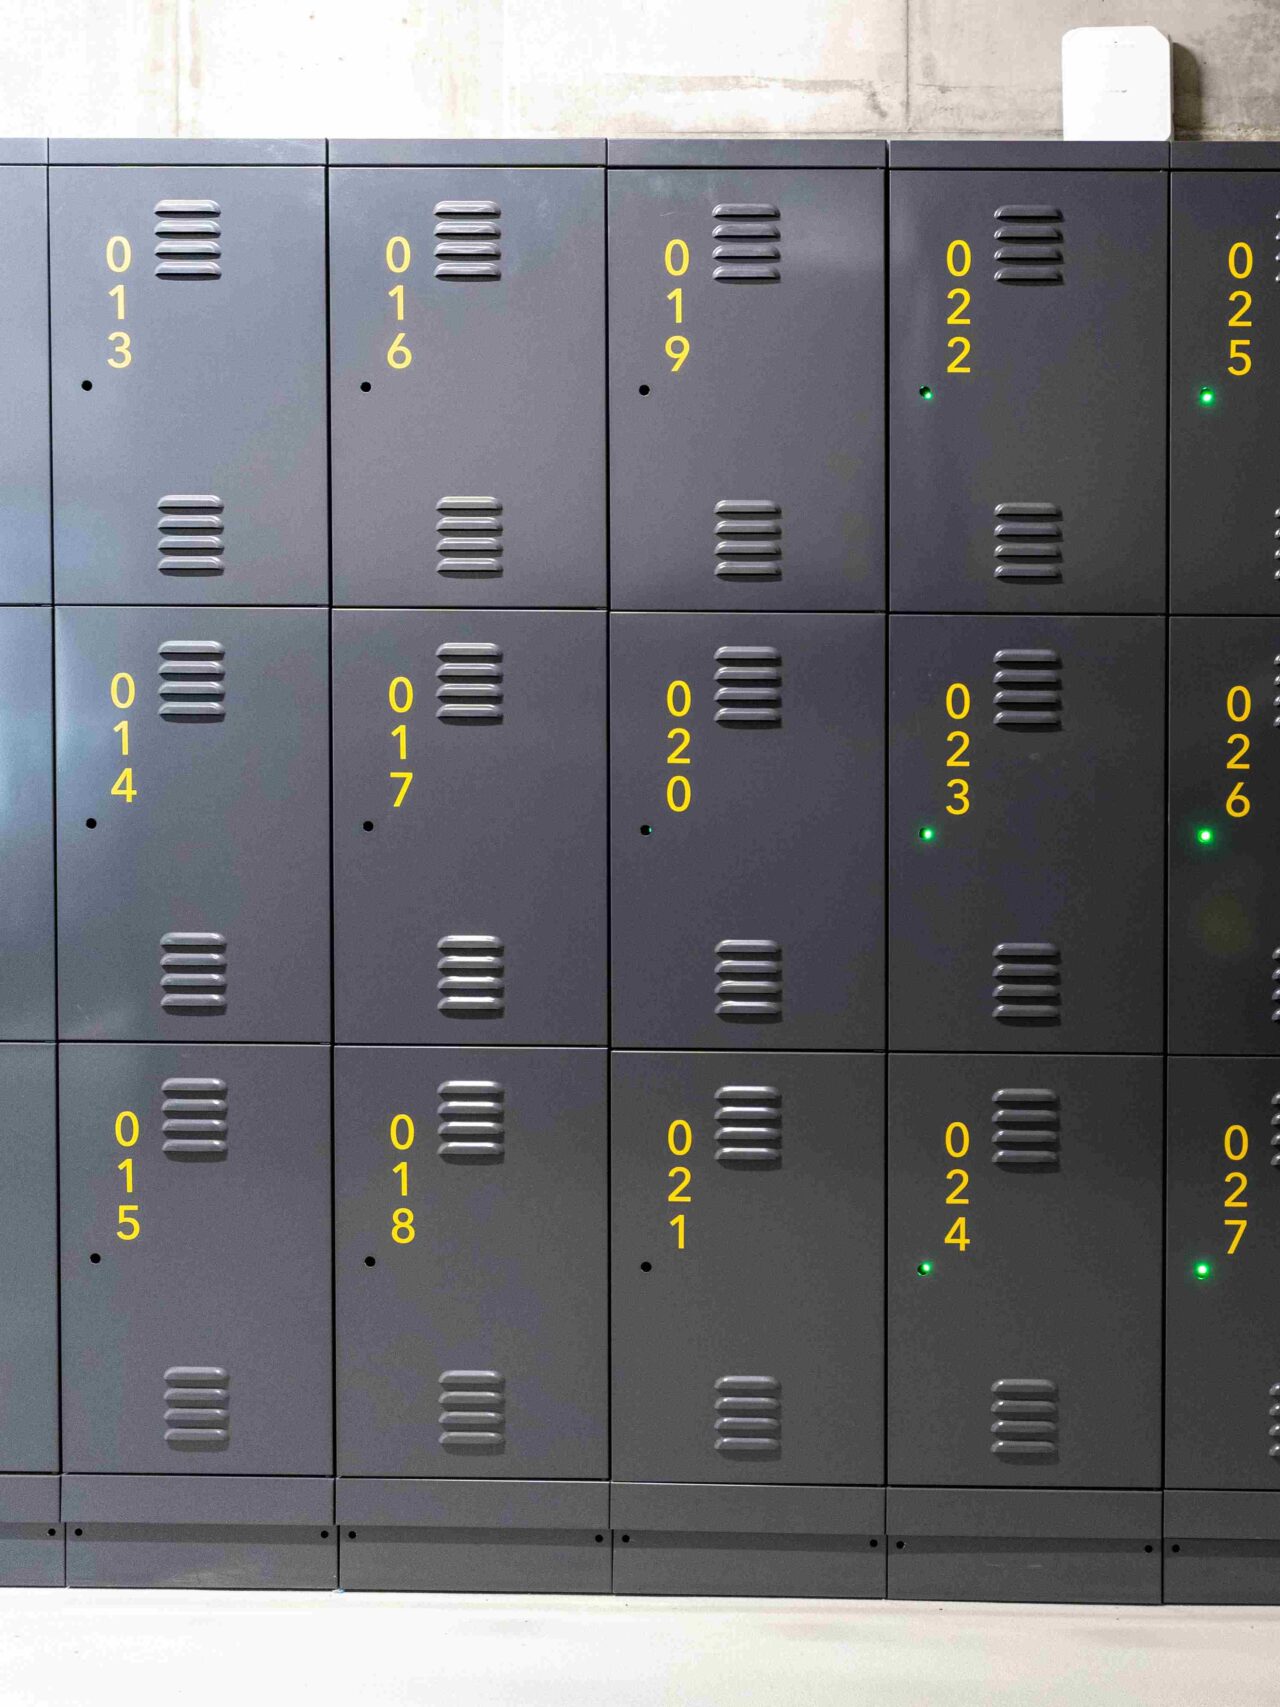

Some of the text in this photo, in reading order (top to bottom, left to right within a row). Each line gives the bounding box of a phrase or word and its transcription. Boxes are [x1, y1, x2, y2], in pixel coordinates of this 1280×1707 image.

[105, 235, 133, 370] 013
[385, 236, 413, 370] 016
[664, 238, 690, 373] 019
[945, 238, 973, 374] 022
[1227, 240, 1254, 377] 025
[110, 672, 138, 803] 014
[387, 675, 414, 809] 017
[665, 679, 692, 813] 020
[944, 681, 971, 816] 023
[1224, 684, 1253, 819] 026
[114, 1110, 141, 1241] 015
[389, 1113, 417, 1245] 018
[666, 1119, 693, 1250] 021
[943, 1120, 972, 1253] 024
[1222, 1123, 1250, 1255] 027
